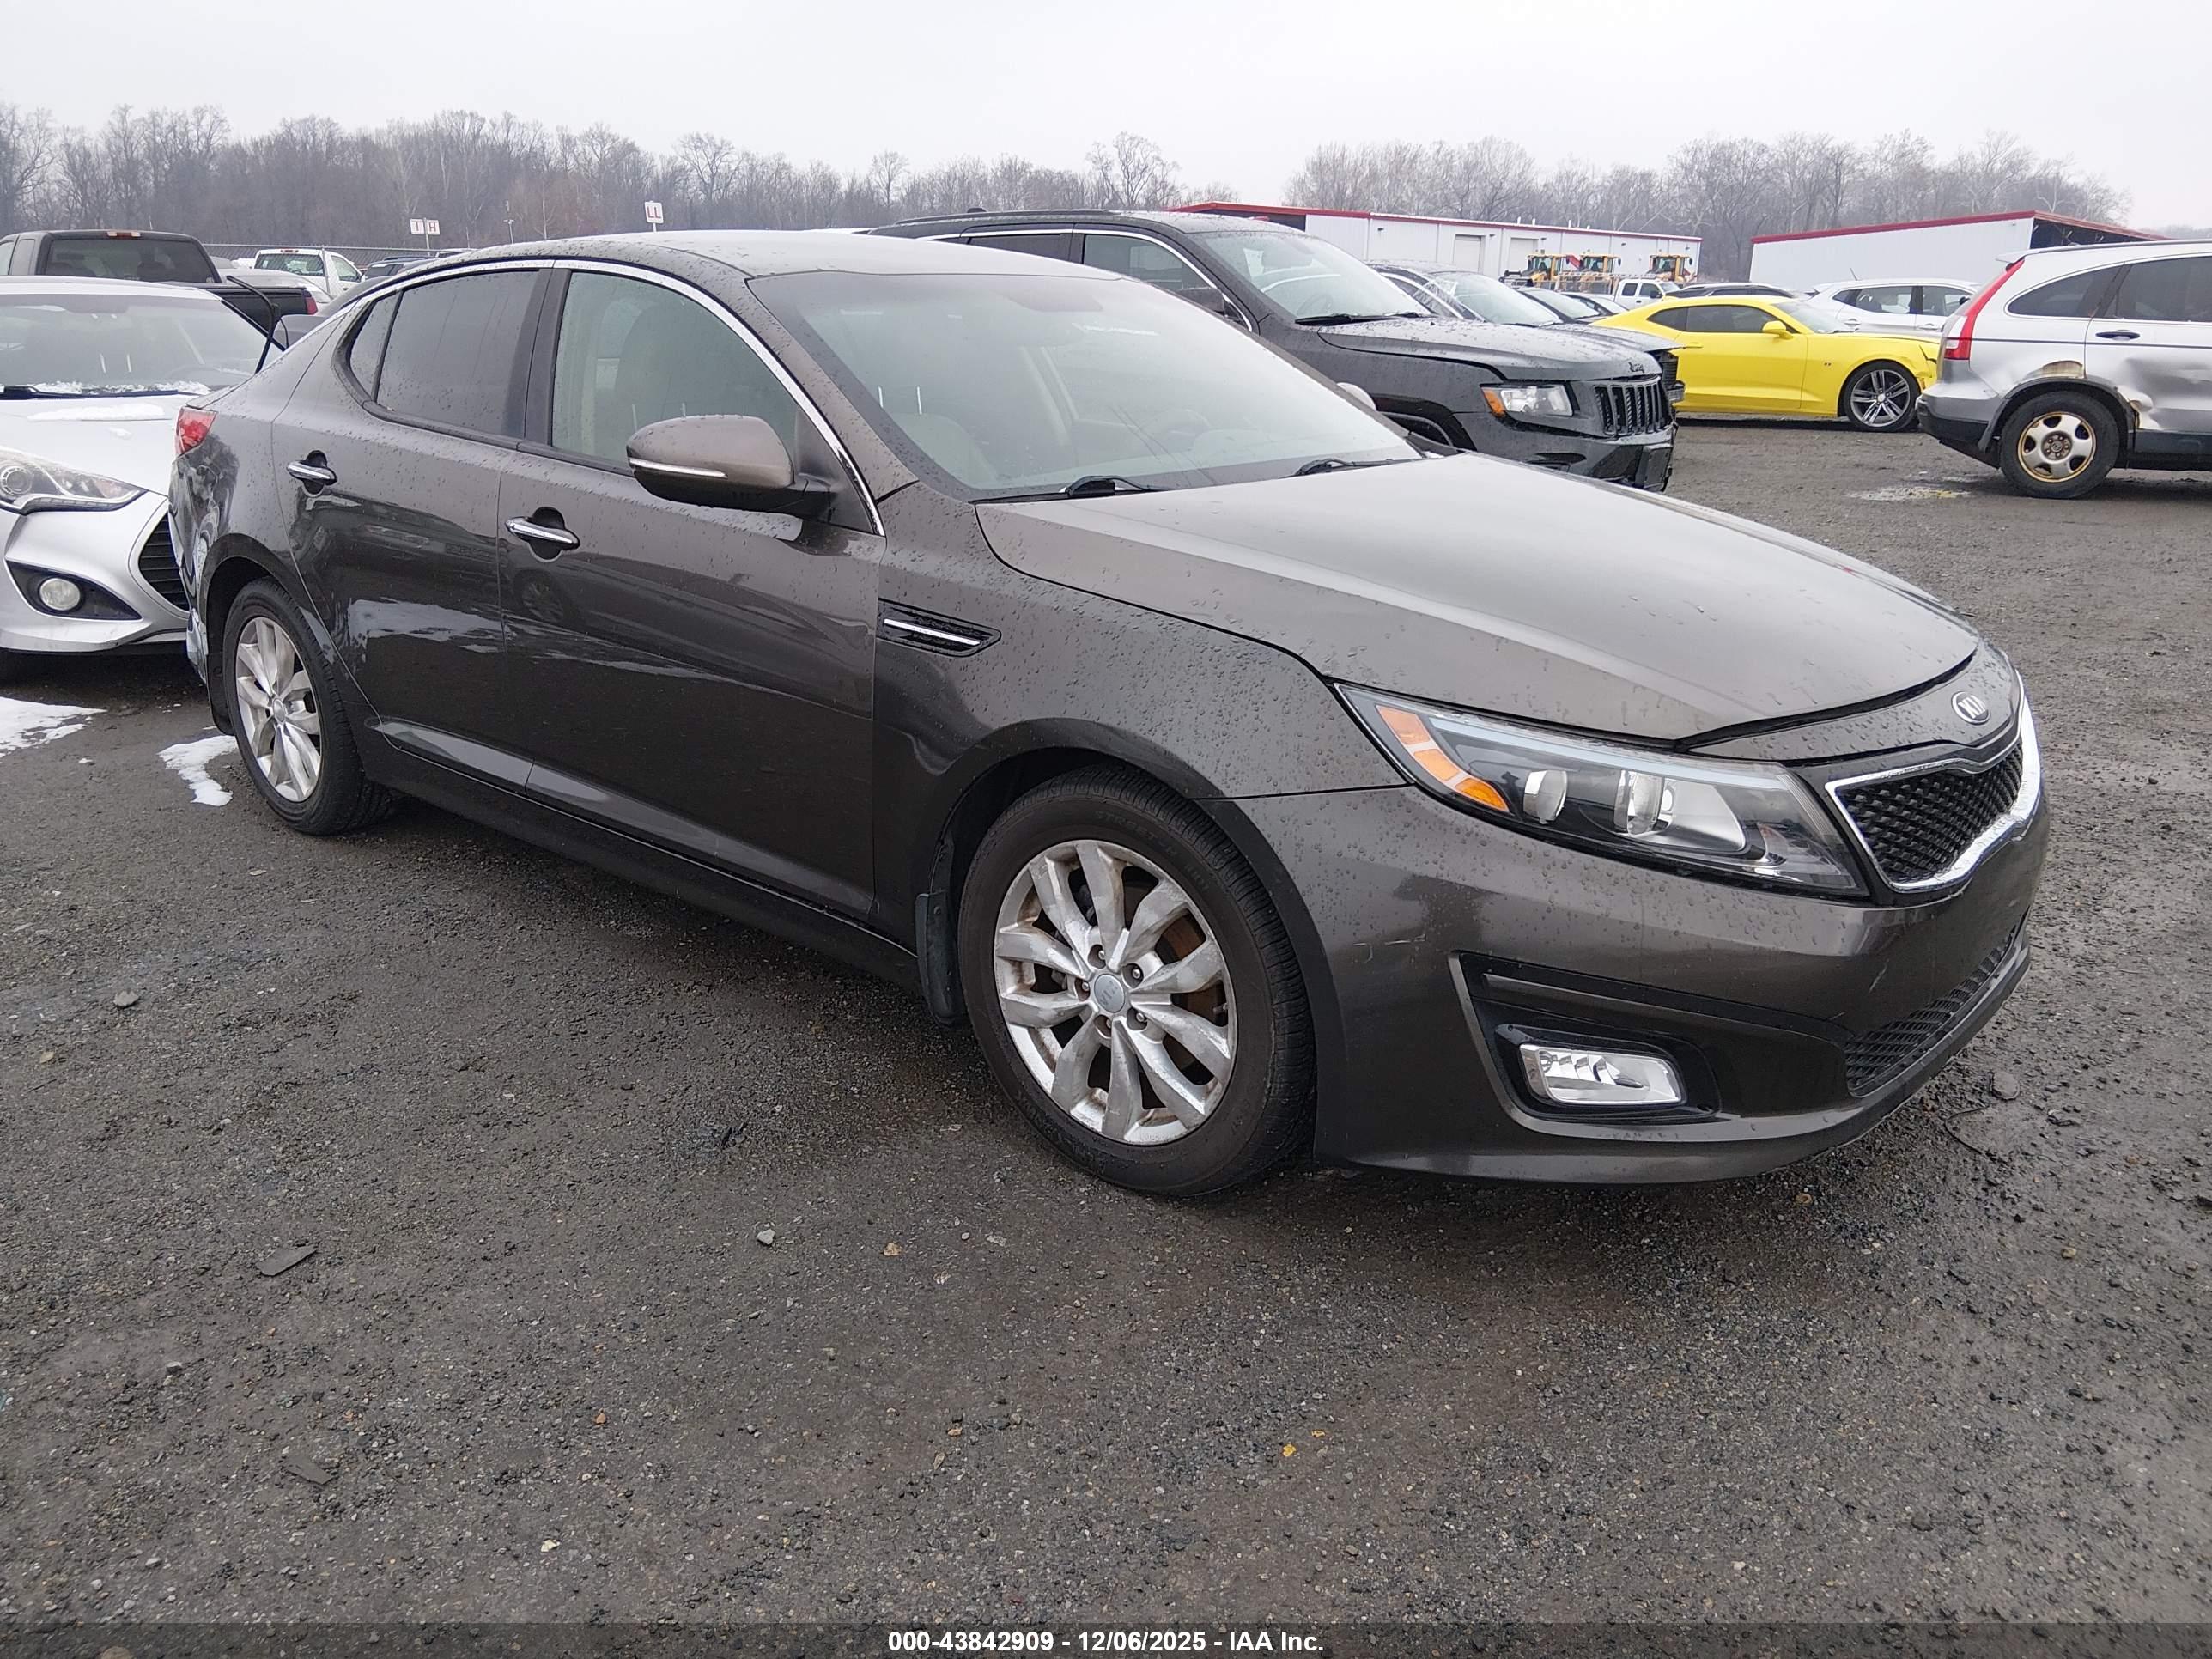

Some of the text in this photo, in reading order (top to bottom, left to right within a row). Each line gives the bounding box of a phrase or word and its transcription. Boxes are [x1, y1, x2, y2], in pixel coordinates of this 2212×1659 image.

[647, 206, 661, 219] LL
[428, 222, 436, 232] H
[1957, 694, 1986, 720] KIA
